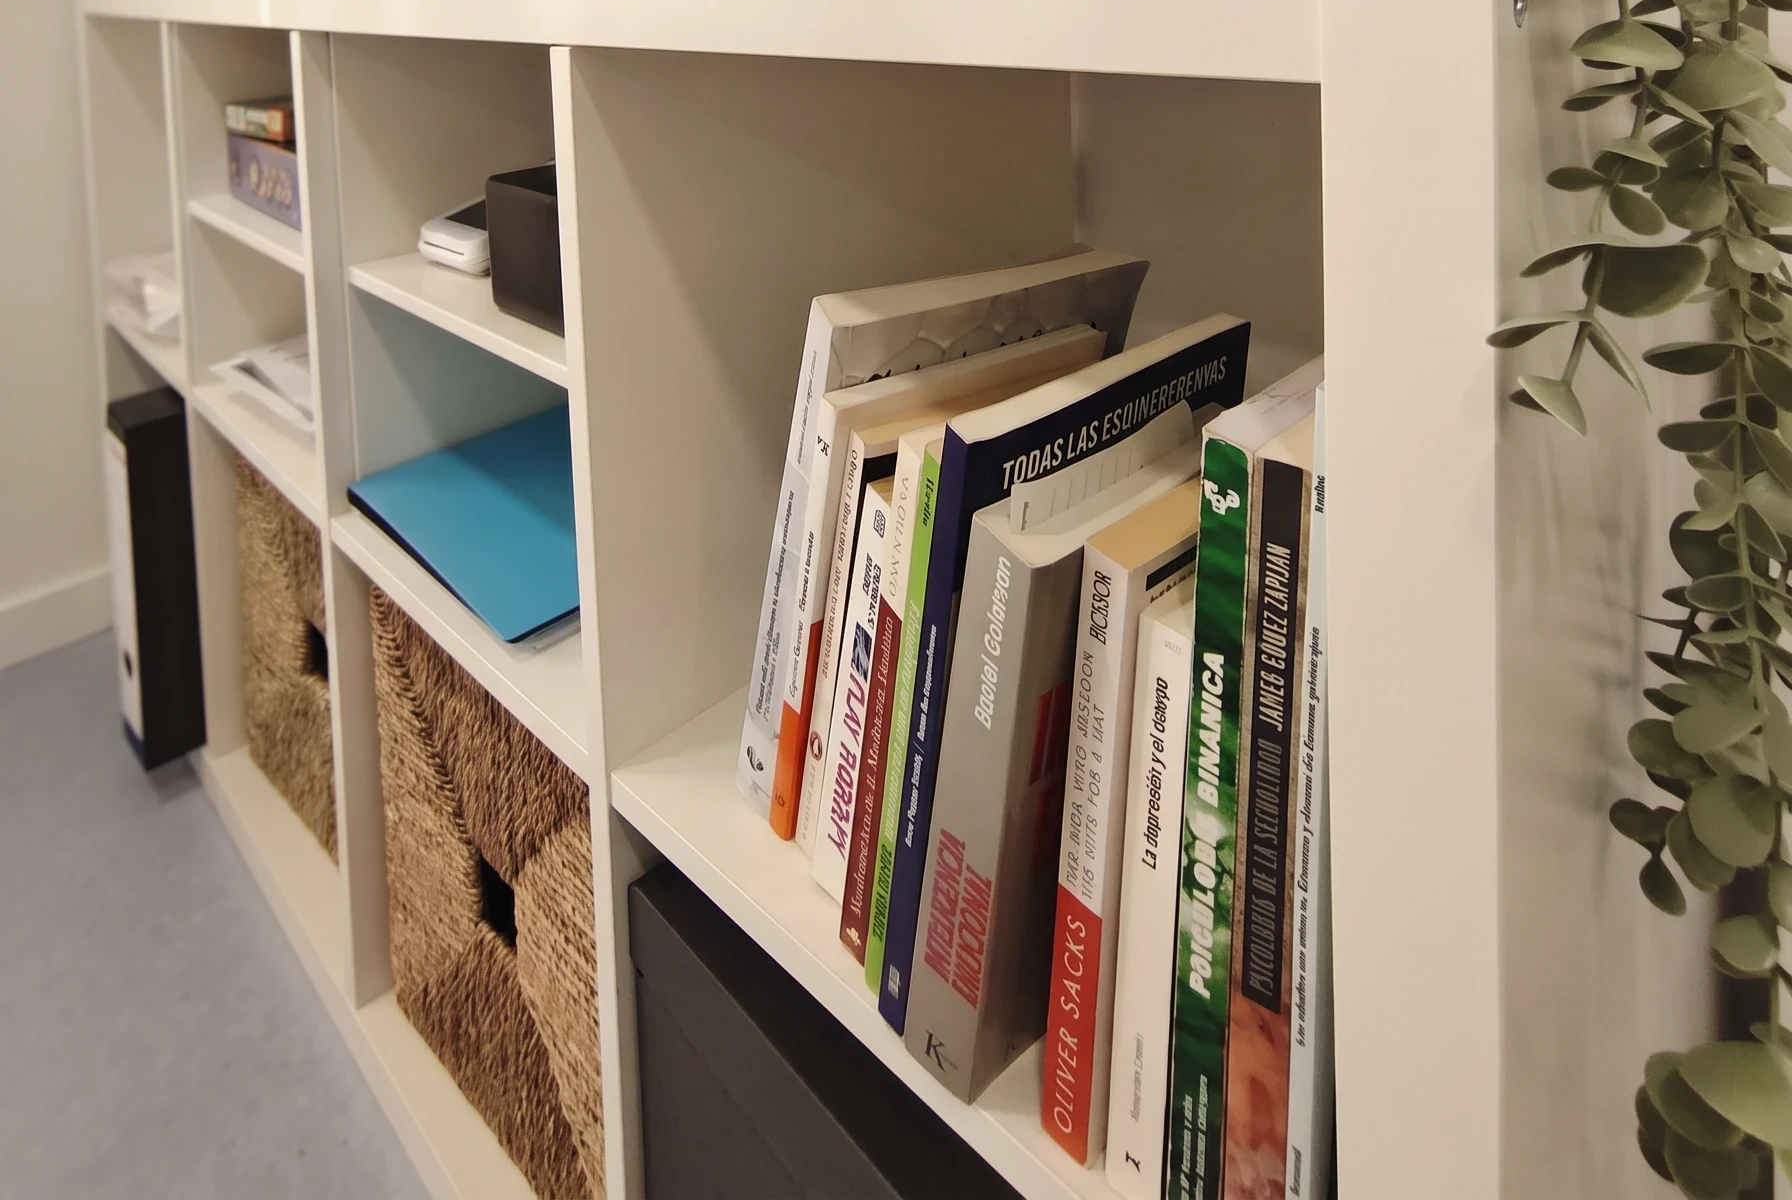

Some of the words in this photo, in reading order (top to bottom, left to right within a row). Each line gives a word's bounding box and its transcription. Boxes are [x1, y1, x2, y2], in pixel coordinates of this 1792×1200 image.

[1002, 437, 1064, 490] TODAS
[1066, 420, 1099, 460] LAS
[1149, 733, 1165, 754] el
[1151, 753, 1167, 770] y
[1141, 847, 1158, 871] La
[1252, 848, 1278, 870] LA
[1060, 914, 1087, 1020] SACKS
[1052, 1026, 1079, 1134] OLIVER
